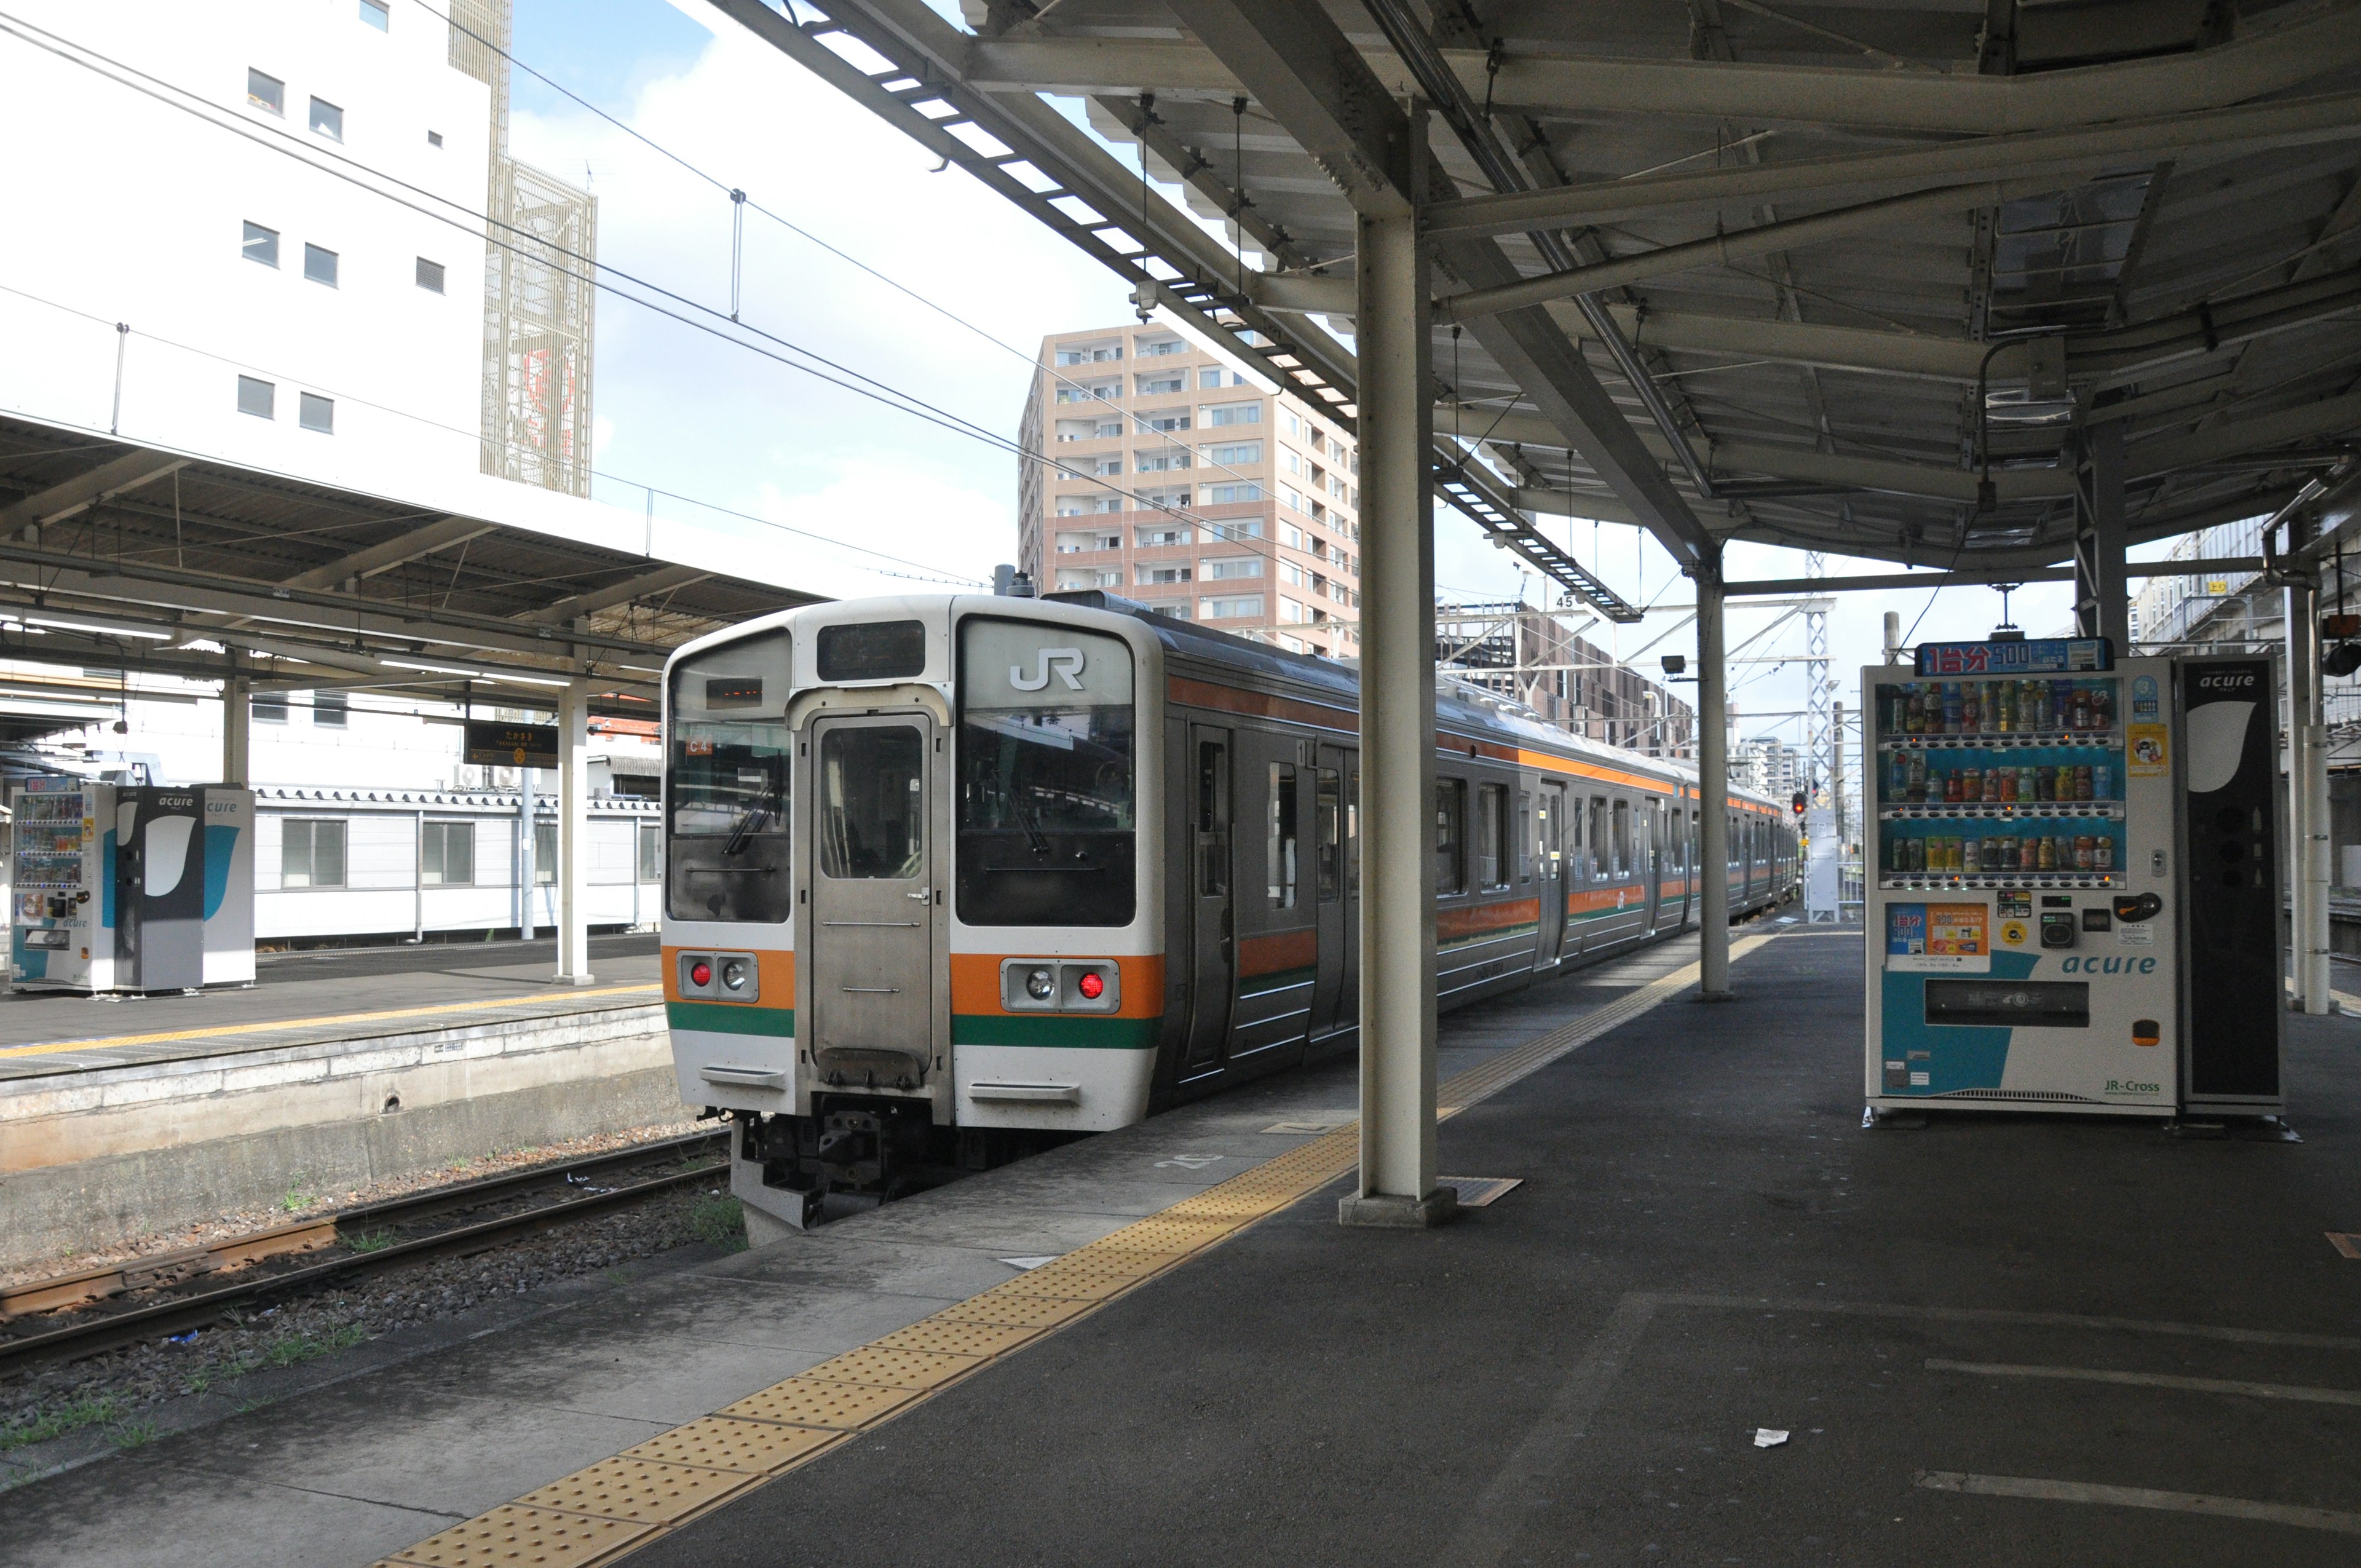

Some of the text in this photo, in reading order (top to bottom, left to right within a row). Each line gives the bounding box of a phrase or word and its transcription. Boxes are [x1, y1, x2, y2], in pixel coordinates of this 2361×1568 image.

[2209, 583, 2226, 592] 上り
[1010, 647, 1084, 691] JR
[2199, 675, 2255, 688] acure
[505, 731, 532, 742] たかさき
[159, 797, 193, 807] acure
[1617, 890, 1624, 910] JR
[63, 919, 87, 928] acure
[2062, 956, 2157, 975] acure
[2105, 1080, 2160, 1091] JR-Cross
